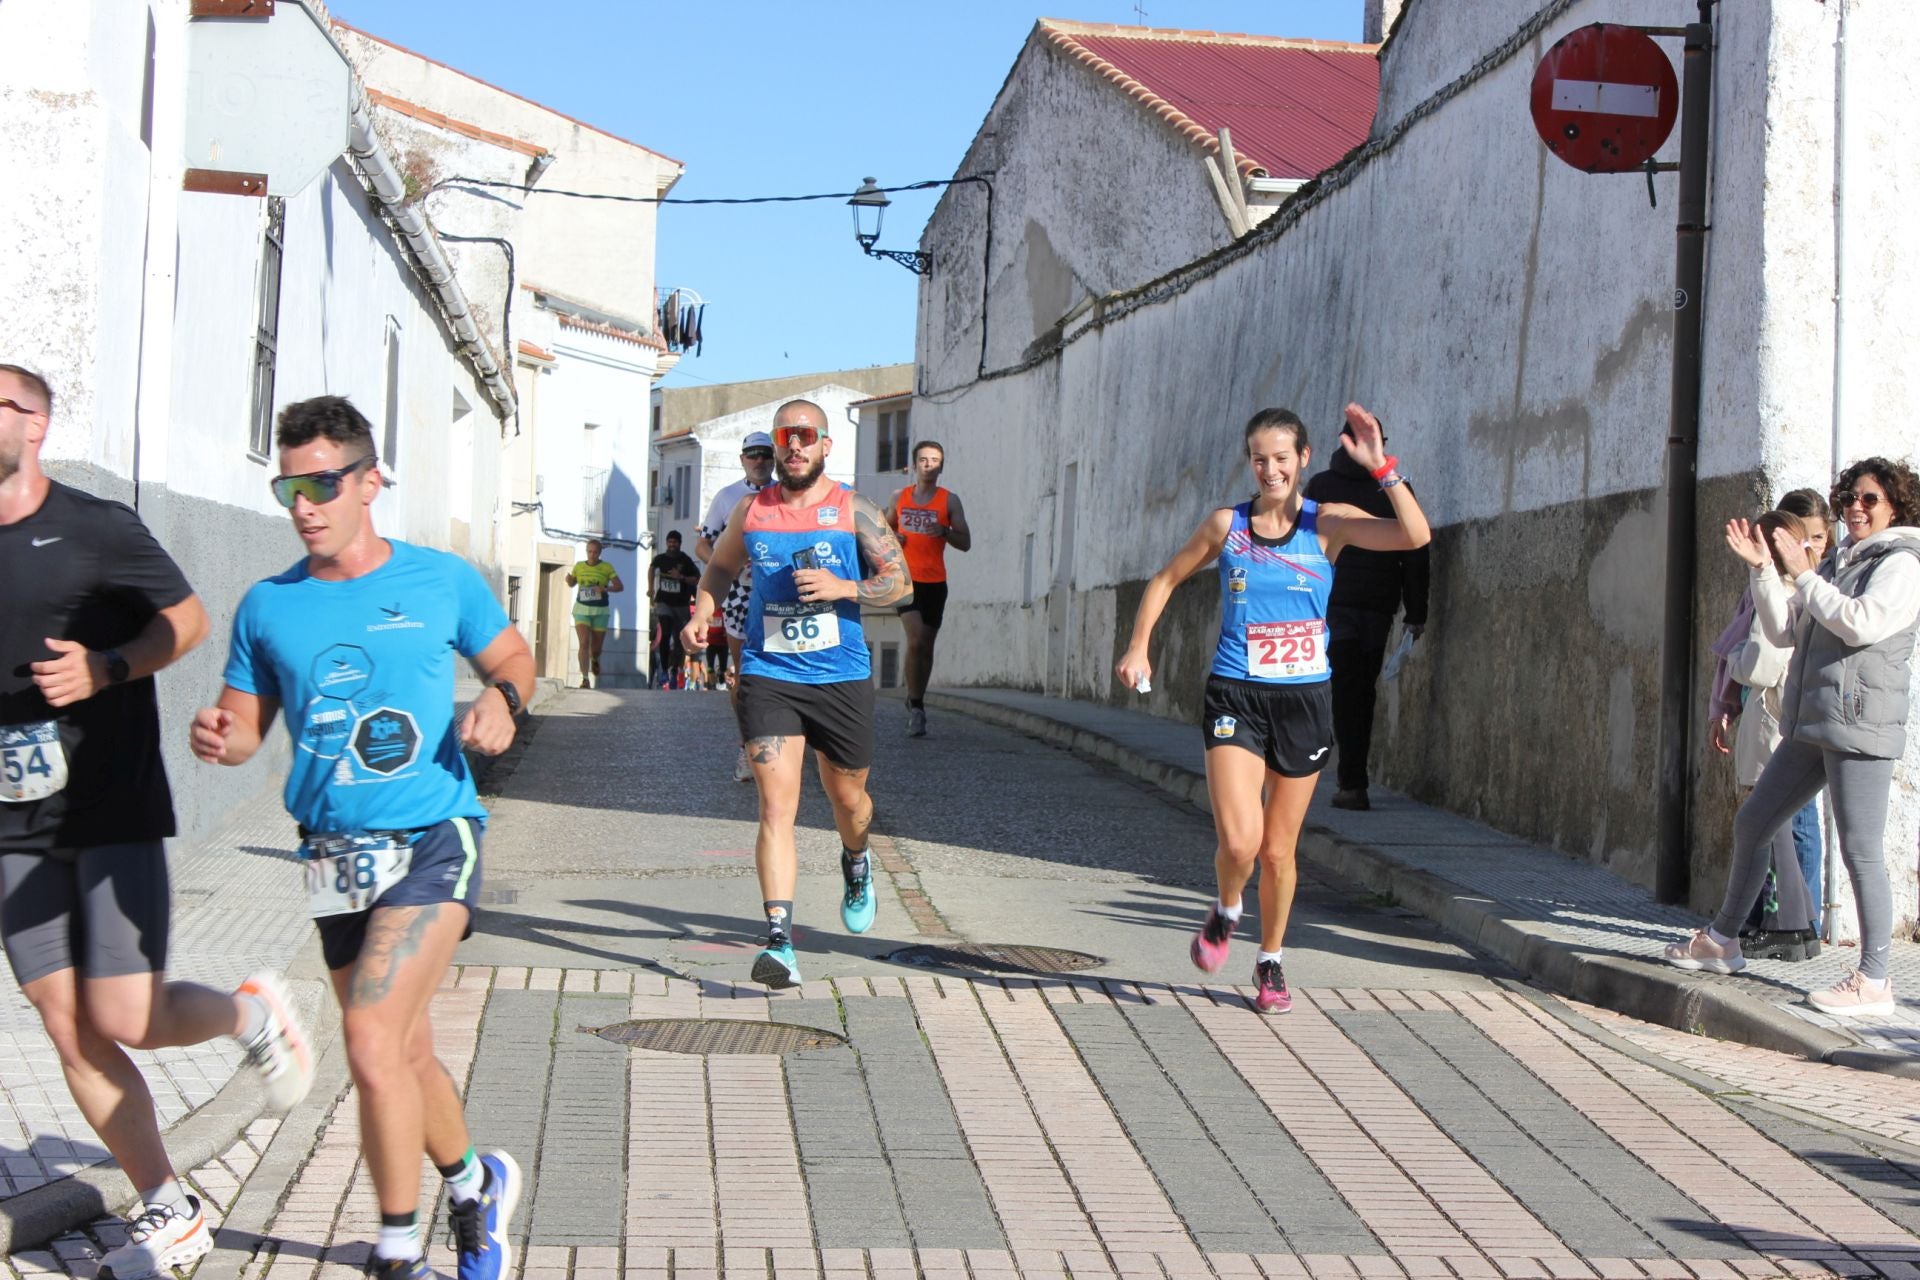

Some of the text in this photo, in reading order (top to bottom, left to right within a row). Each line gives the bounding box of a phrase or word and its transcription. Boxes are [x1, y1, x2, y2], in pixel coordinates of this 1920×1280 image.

[781, 616, 819, 641] 66
[1259, 637, 1316, 665] 229
[0, 745, 51, 783] 54
[335, 852, 375, 894] 88
